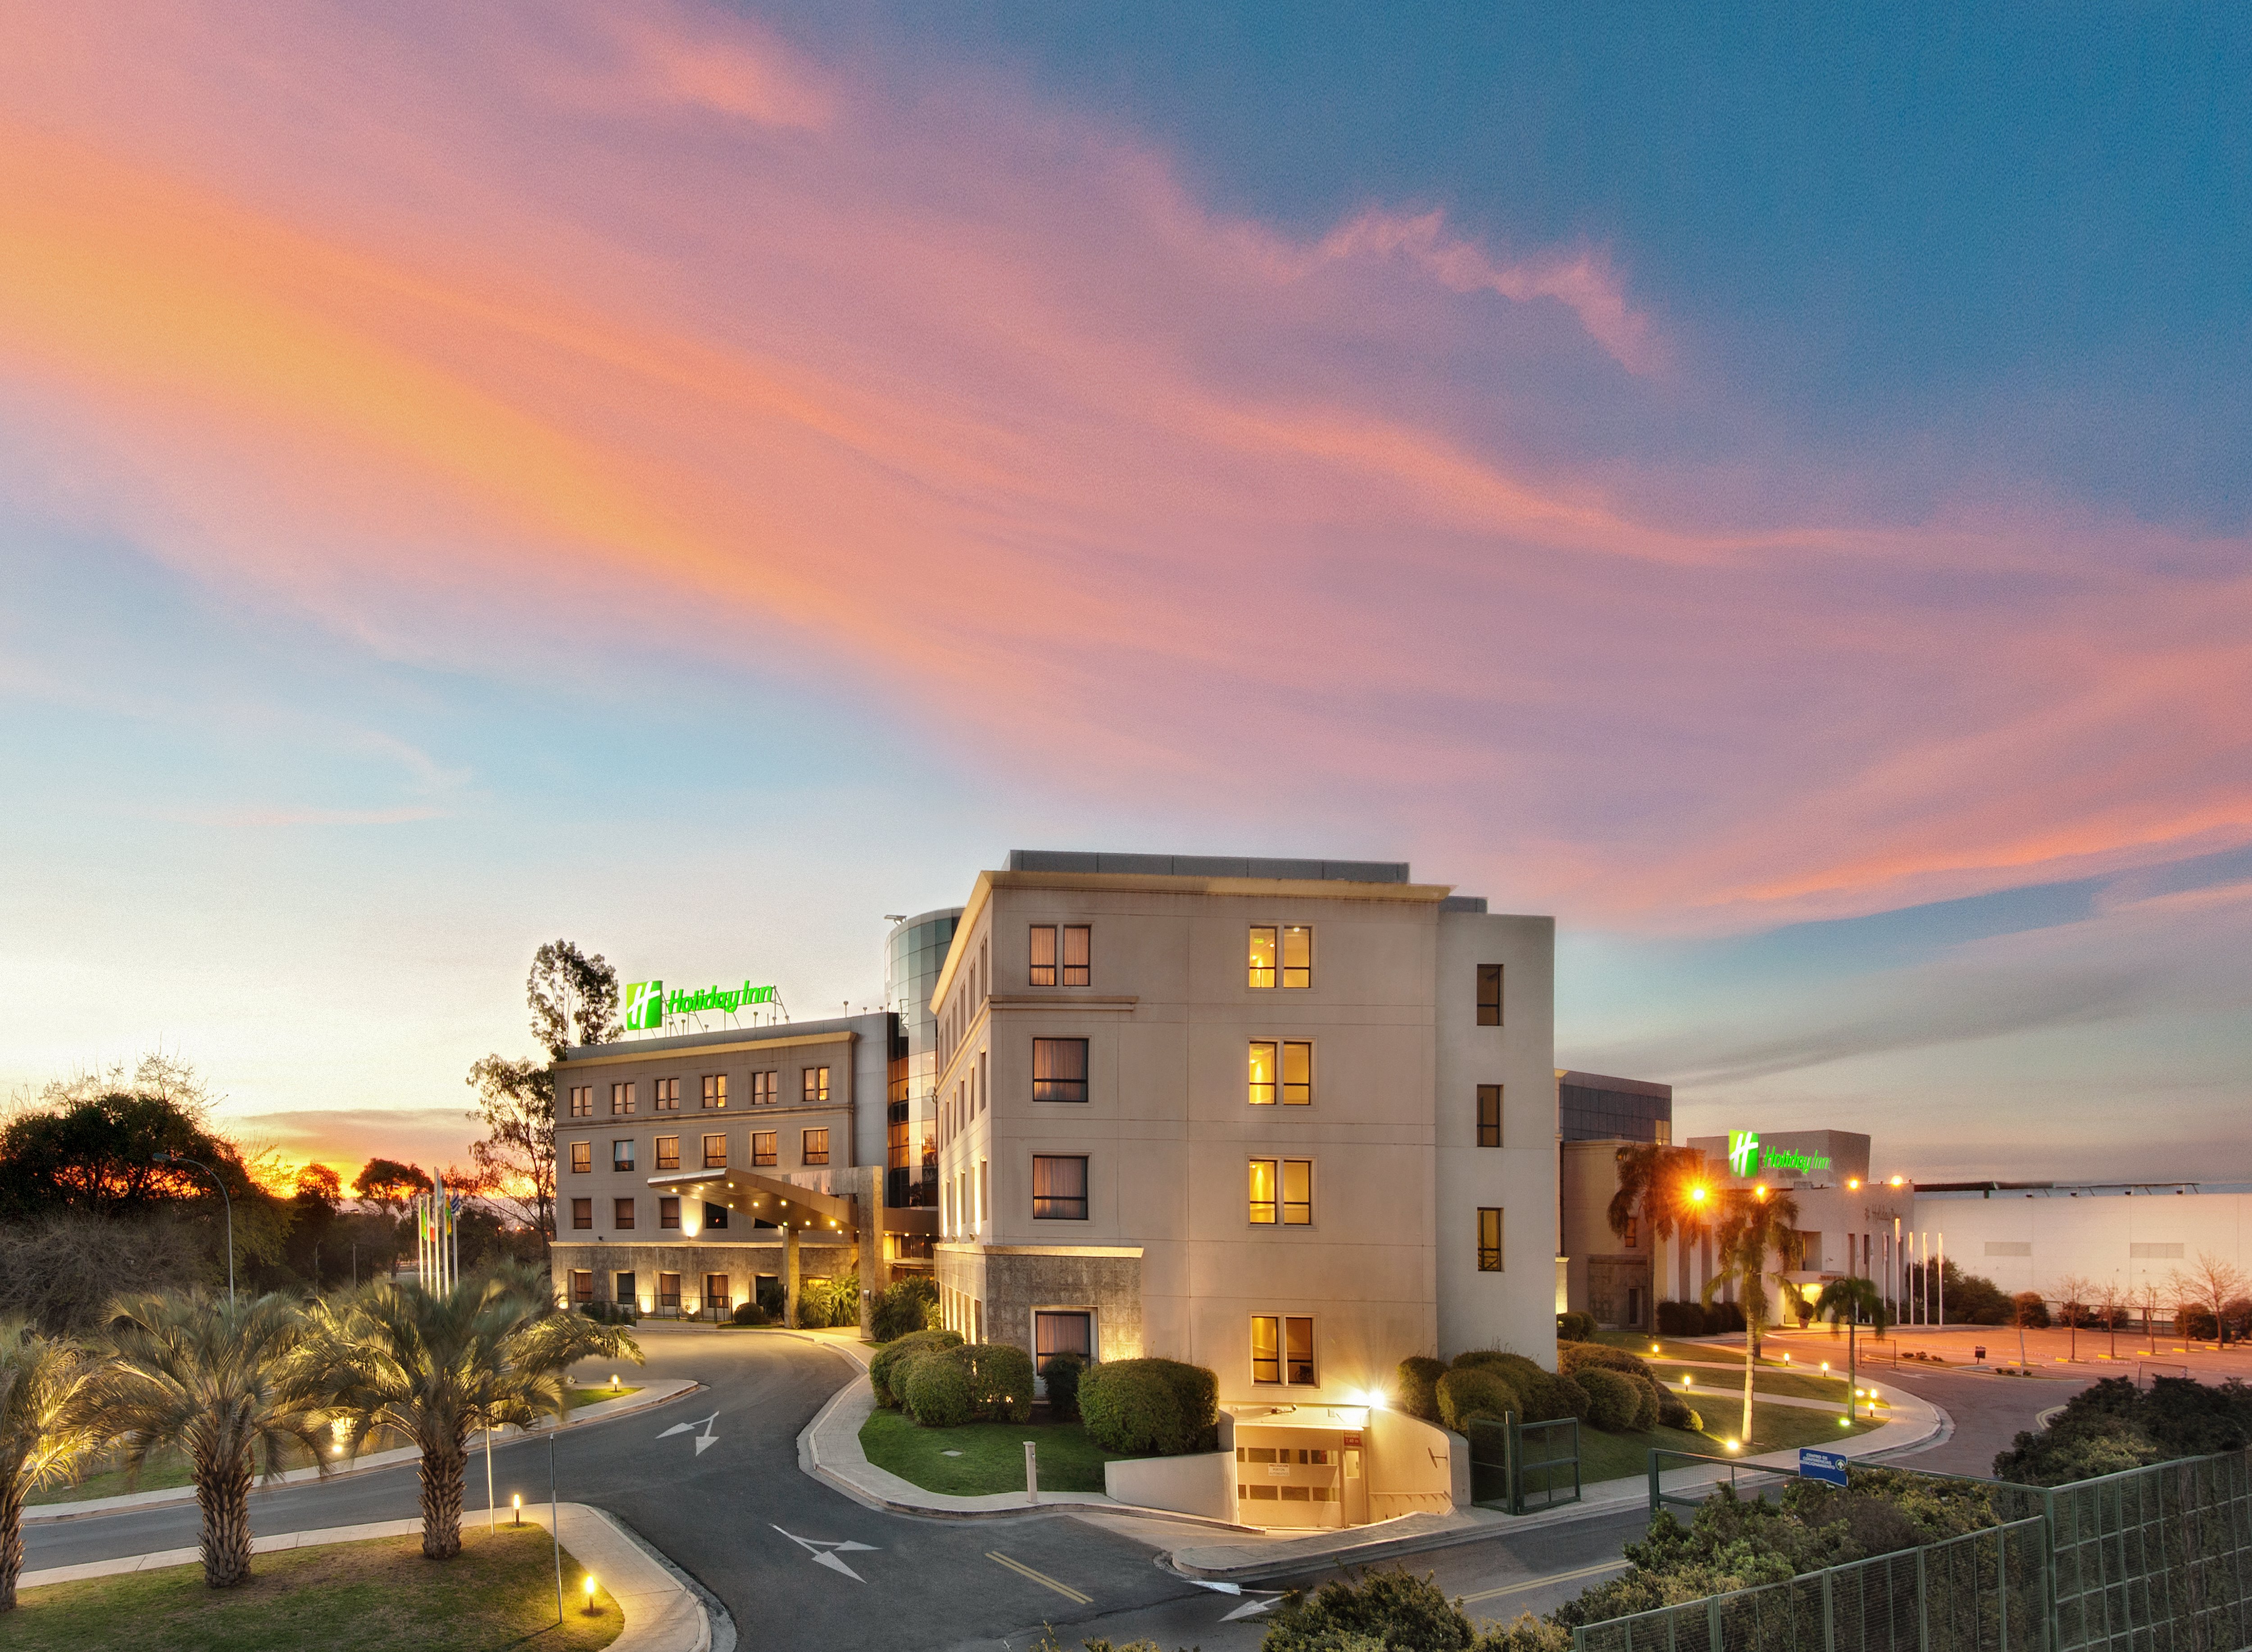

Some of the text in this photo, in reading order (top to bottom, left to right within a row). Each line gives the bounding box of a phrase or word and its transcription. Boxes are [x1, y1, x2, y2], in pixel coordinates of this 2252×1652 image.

[668, 980, 772, 1014] Holiday Inn
[1764, 1145, 1830, 1174] Holiday Inn
